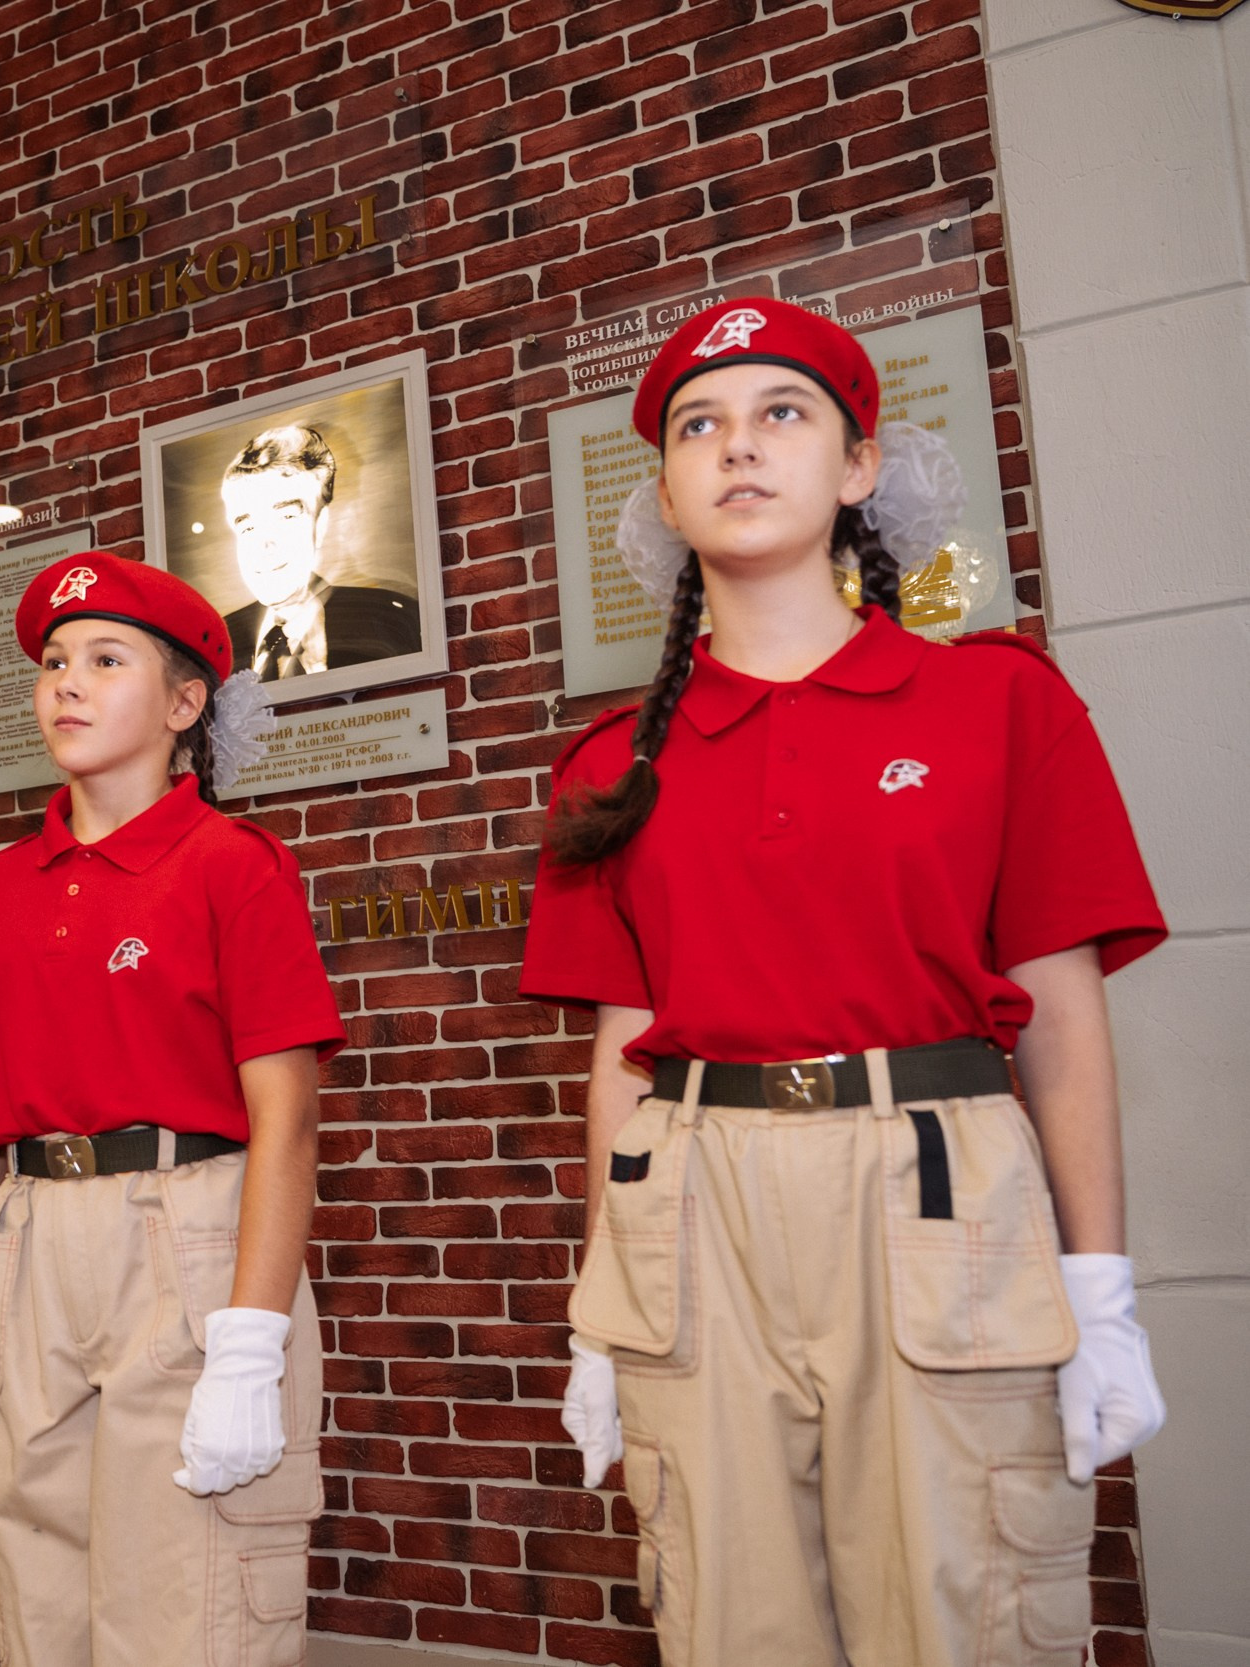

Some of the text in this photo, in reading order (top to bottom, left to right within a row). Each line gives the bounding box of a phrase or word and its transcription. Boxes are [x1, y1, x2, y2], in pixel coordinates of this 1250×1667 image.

[91, 193, 382, 335] ШКОЛЫ
[564, 314, 648, 350] ВЕЧНАЯ
[568, 385, 579, 396] В
[584, 371, 630, 393] ГОДЫ
[837, 306, 876, 327] НОЙ
[882, 288, 954, 317] ВОЙНЫ
[885, 354, 928, 373] Иван
[581, 429, 623, 447] Белов
[582, 439, 648, 462] Белоного
[583, 451, 660, 477] Великосел
[584, 472, 642, 492] Веселов
[586, 507, 619, 522] Гора
[587, 524, 618, 538] Ерм
[588, 537, 615, 553] Зай
[589, 554, 623, 568] Засо
[254, 707, 410, 742] ЕРИЙ АЛЕКСАНДРОВИЧ
[268, 743, 286, 753] 939
[295, 733, 345, 749] 04.01.2003
[236, 774, 261, 785] едней
[264, 770, 295, 780] школы
[331, 759, 351, 770] 1974
[369, 753, 393, 764] 2003
[238, 743, 381, 774] енный учитель школы РСФСР
[324, 878, 527, 943] ГИМН
